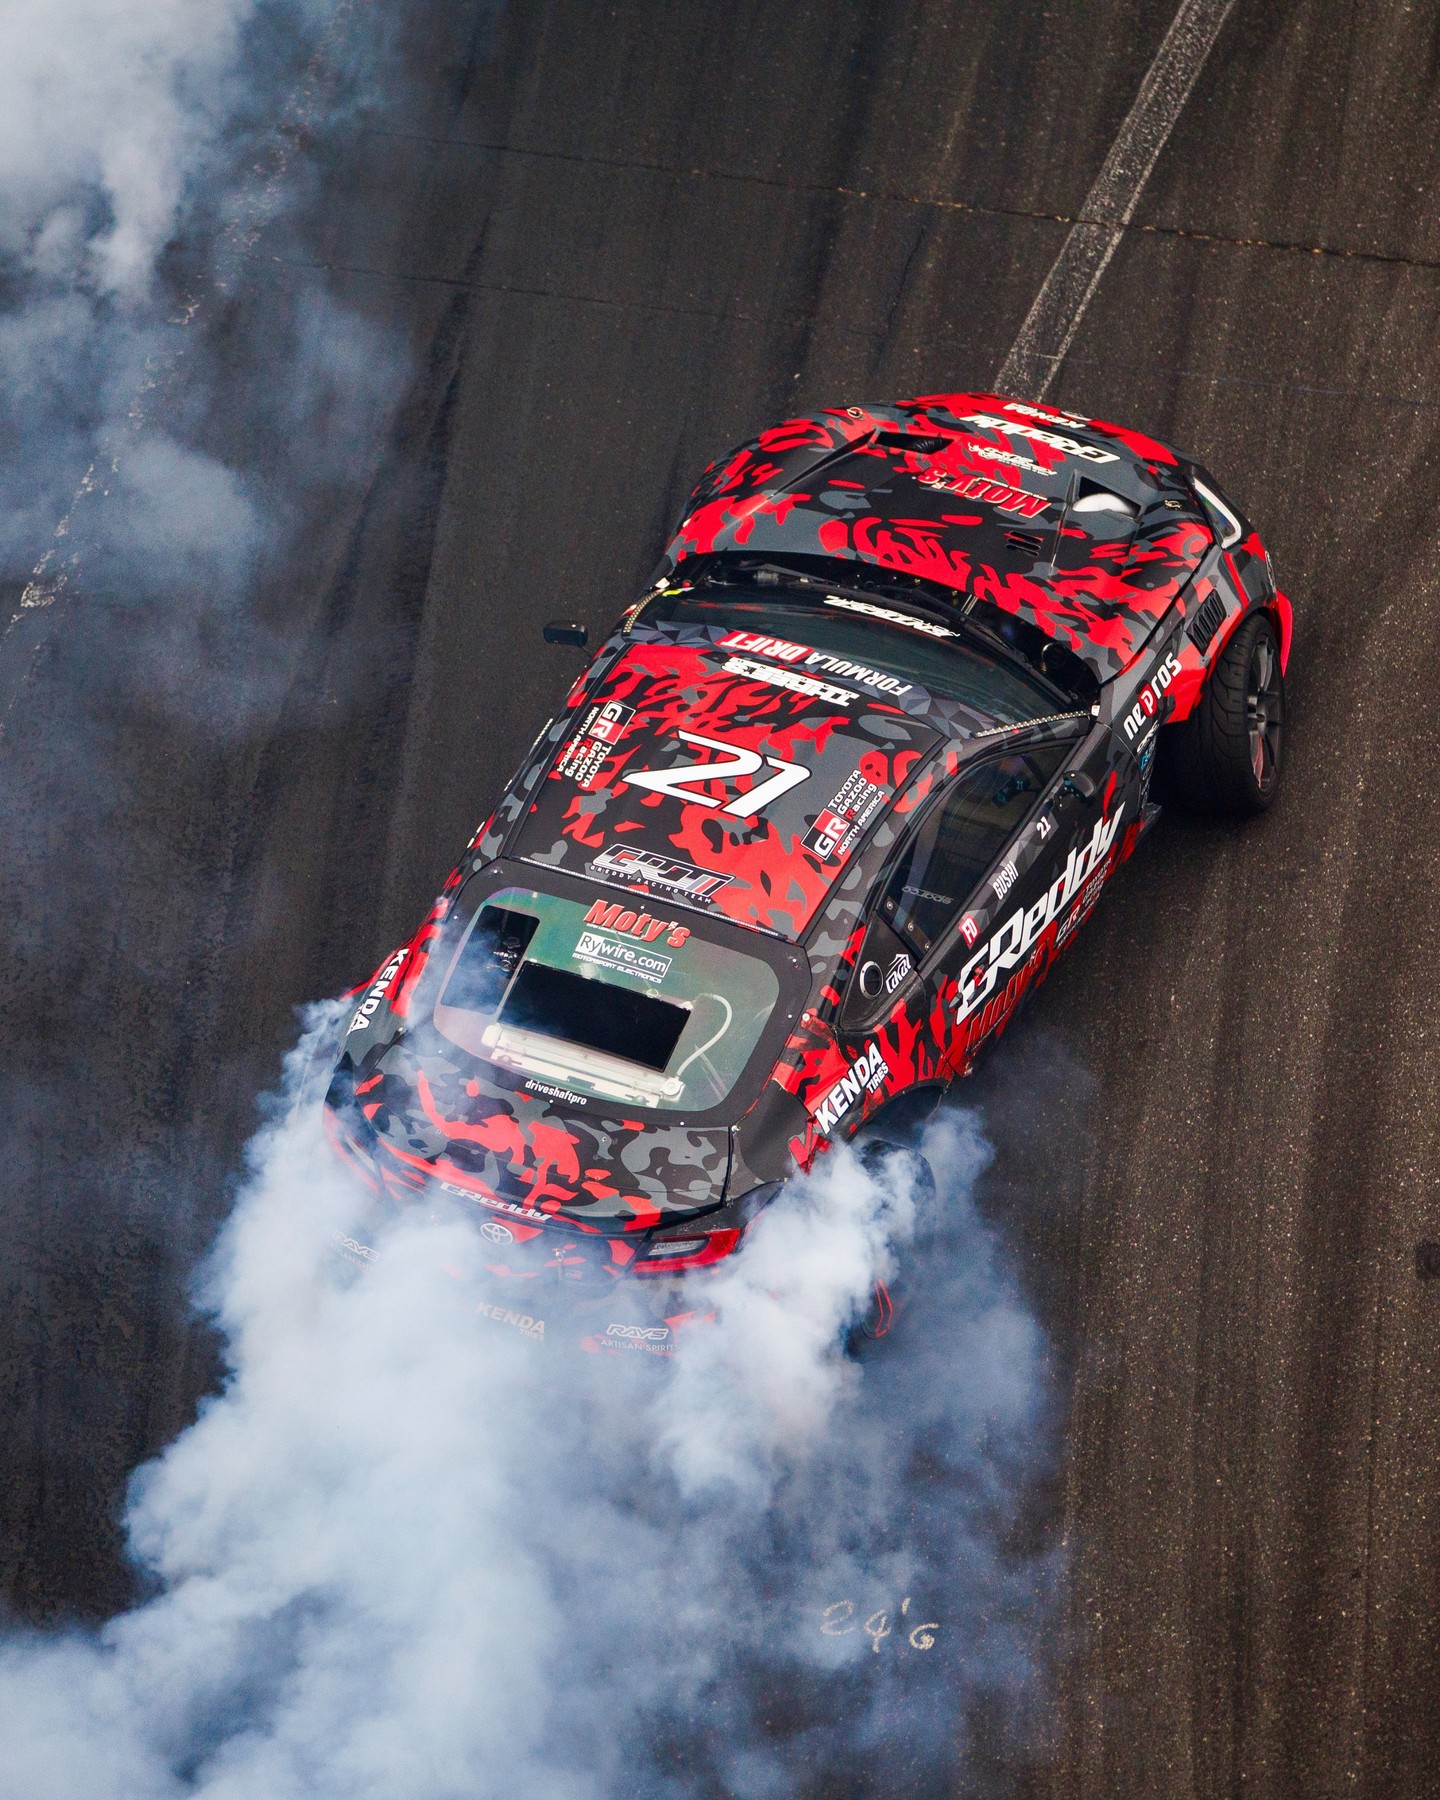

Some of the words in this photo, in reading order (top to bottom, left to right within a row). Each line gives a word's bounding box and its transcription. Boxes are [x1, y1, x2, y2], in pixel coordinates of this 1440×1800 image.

[722, 632, 809, 662] DRIFT
[721, 658, 856, 707] THREE'S
[804, 651, 913, 697] FORMULA
[579, 706, 600, 735] NORTH
[591, 701, 623, 740] GR
[556, 734, 583, 773] AMERICA
[564, 738, 594, 778] Racing
[574, 740, 603, 782] GAZOO
[581, 745, 612, 788] TOYOTA
[622, 729, 813, 819] 21
[827, 768, 863, 808] TOYOTA
[837, 777, 867, 815] GAZOO
[846, 782, 878, 820] Racing
[812, 818, 850, 859] GR
[837, 826, 860, 856] NORTH
[858, 789, 886, 834] AMERICA
[1036, 816, 1051, 840] 21
[589, 864, 633, 880] GREDDY
[636, 876, 680, 895] RACING
[683, 890, 713, 905] TEAM
[992, 861, 1019, 900] GUSHI
[583, 899, 692, 949] Moty's
[962, 917, 978, 945] FD
[579, 934, 667, 973] Rywire.com
[352, 948, 410, 1032] KENDA
[525, 1079, 588, 1106] driveshaftpro
[813, 1043, 885, 1135] KENDA
[865, 1062, 889, 1093] TIRES
[475, 1301, 546, 1334] KENDA
[606, 1323, 670, 1341] RAYS
[600, 1338, 643, 1352] ARTISAN
